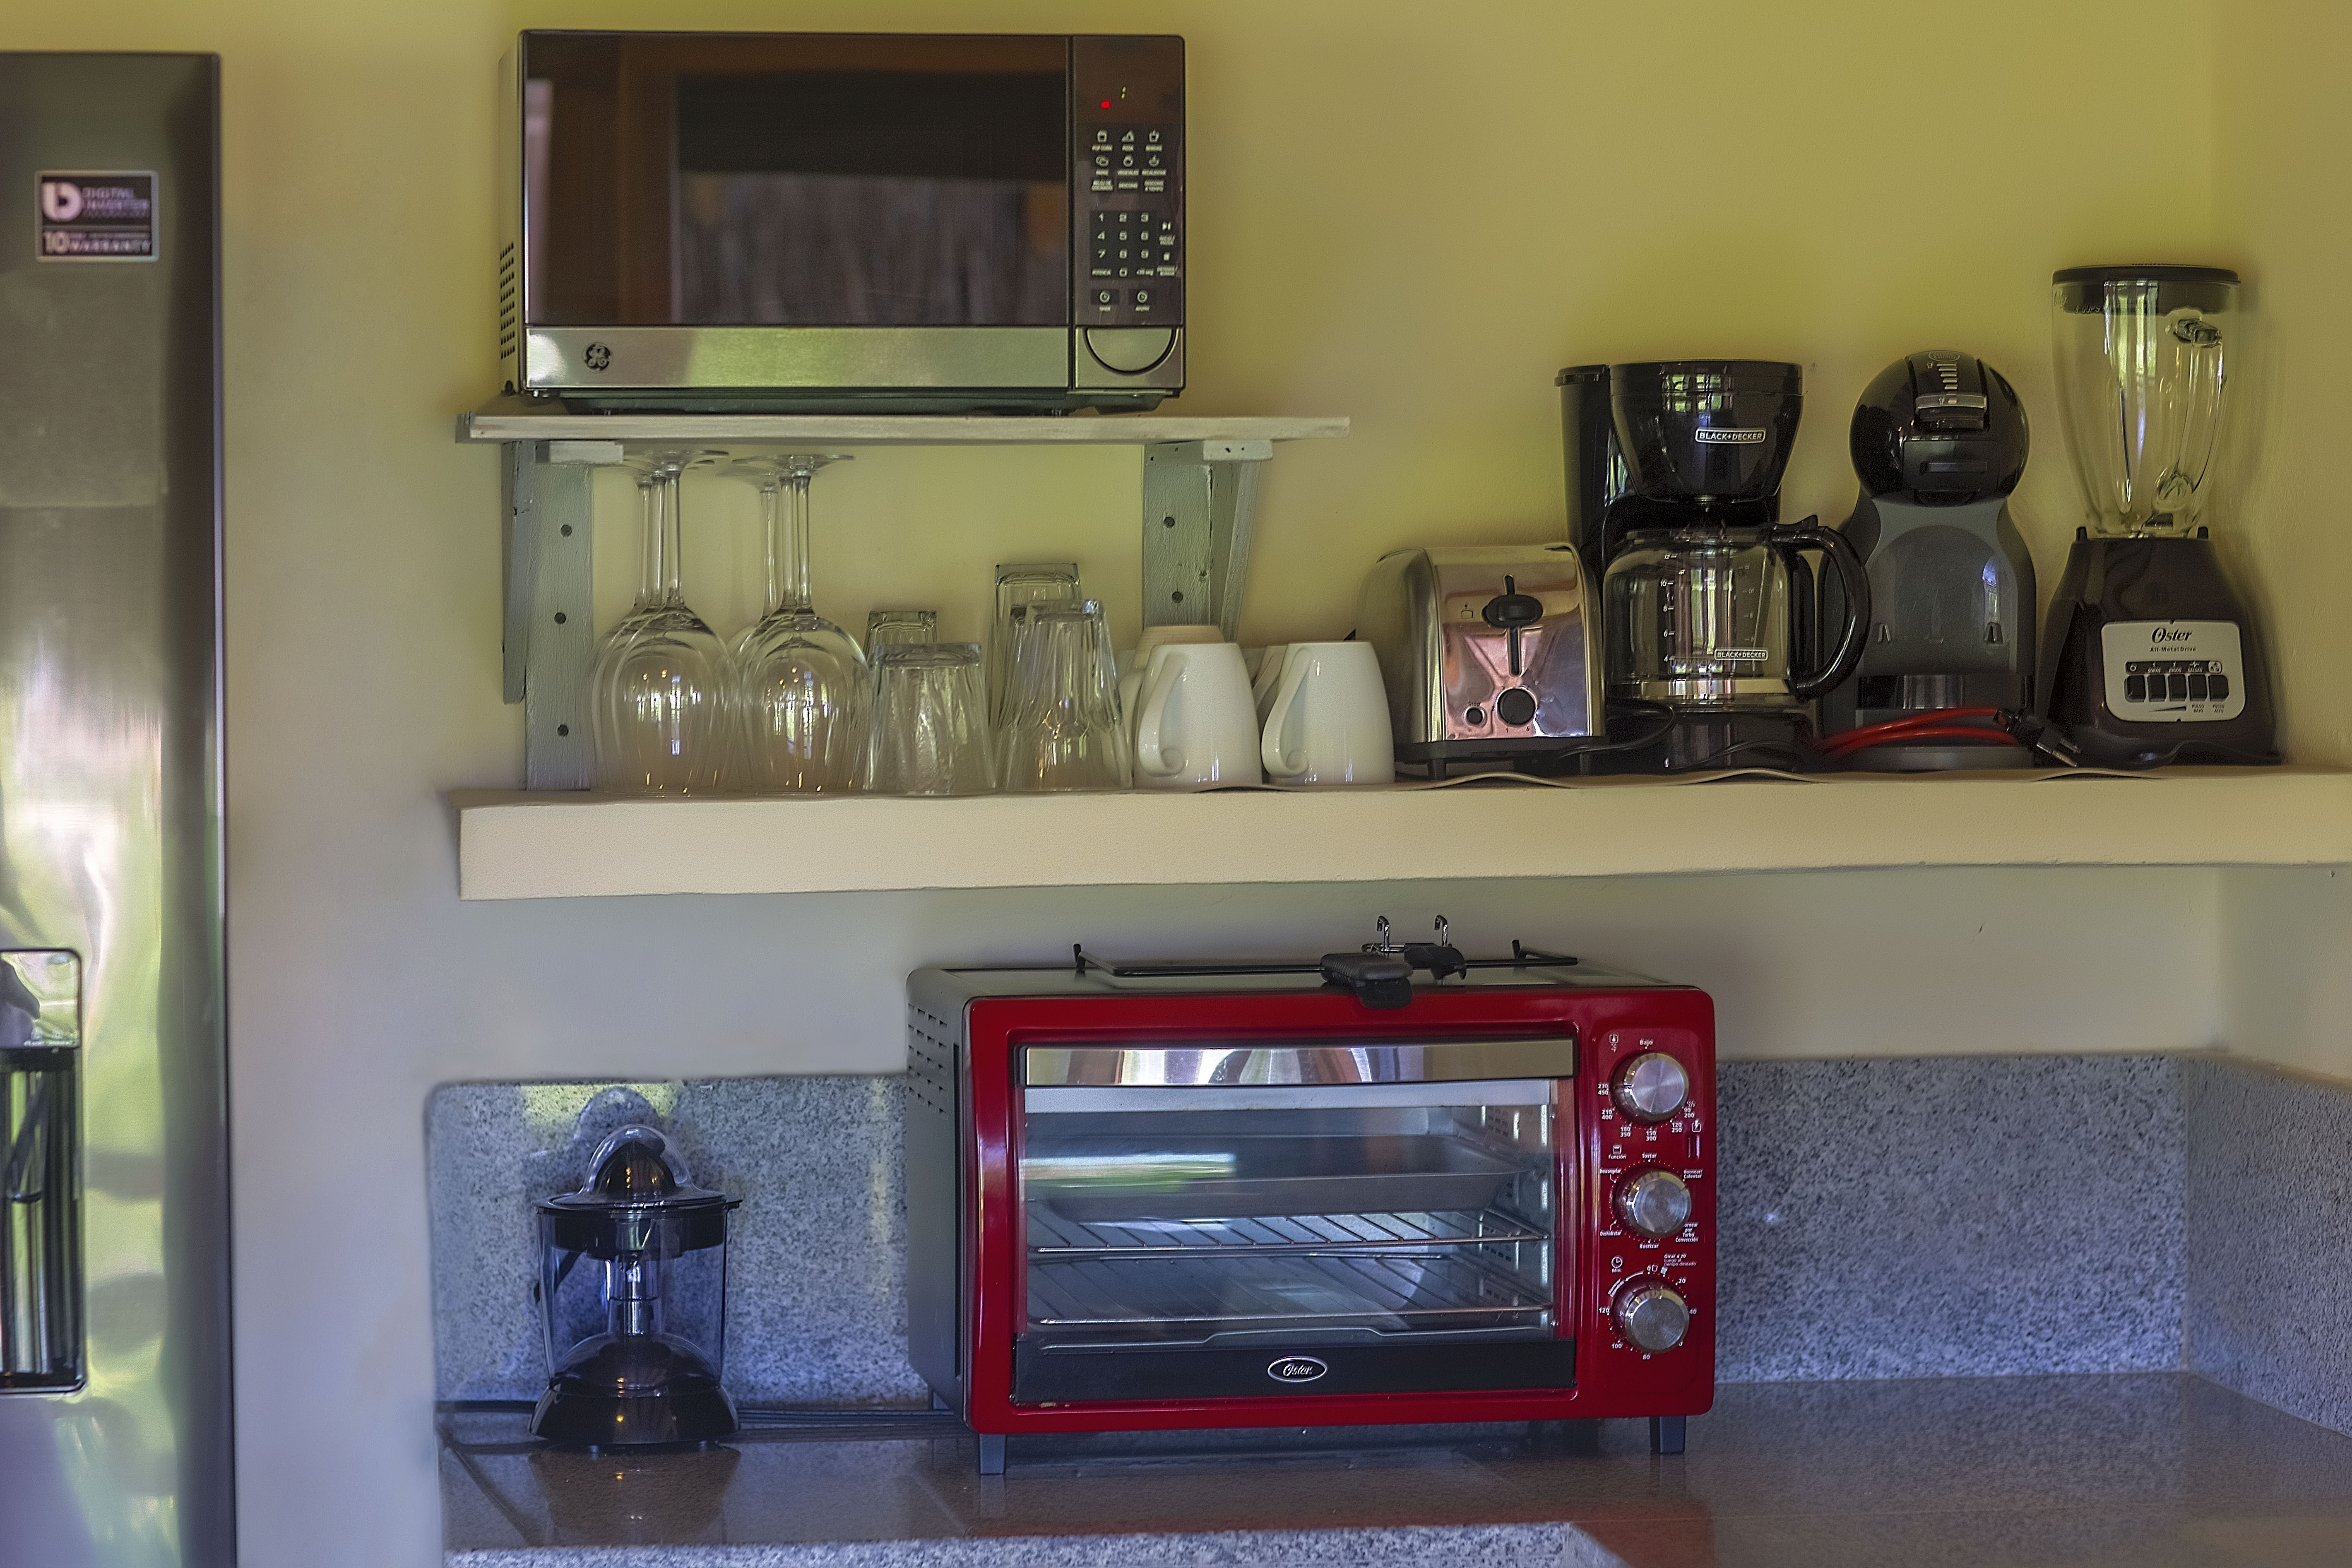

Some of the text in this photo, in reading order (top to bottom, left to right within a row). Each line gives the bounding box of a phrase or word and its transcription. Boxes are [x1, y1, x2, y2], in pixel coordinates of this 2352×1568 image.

[1099, 213, 1104, 221] 1
[1119, 213, 1127, 222] 2
[1141, 213, 1149, 222] 3
[1098, 231, 1105, 240] 4
[1119, 231, 1127, 240] 5
[1141, 231, 1149, 240] 6
[43, 231, 70, 253] 10
[1098, 249, 1106, 258] 7
[1119, 249, 1127, 259] 8
[1141, 249, 1149, 259] 9
[1699, 431, 1762, 440] BLACK+DECKER
[2151, 627, 2193, 644] Oster
[1607, 1278, 1621, 1295] Mantener
[1610, 1280, 1624, 1298] Encendido
[1283, 1363, 1313, 1376] Oster
